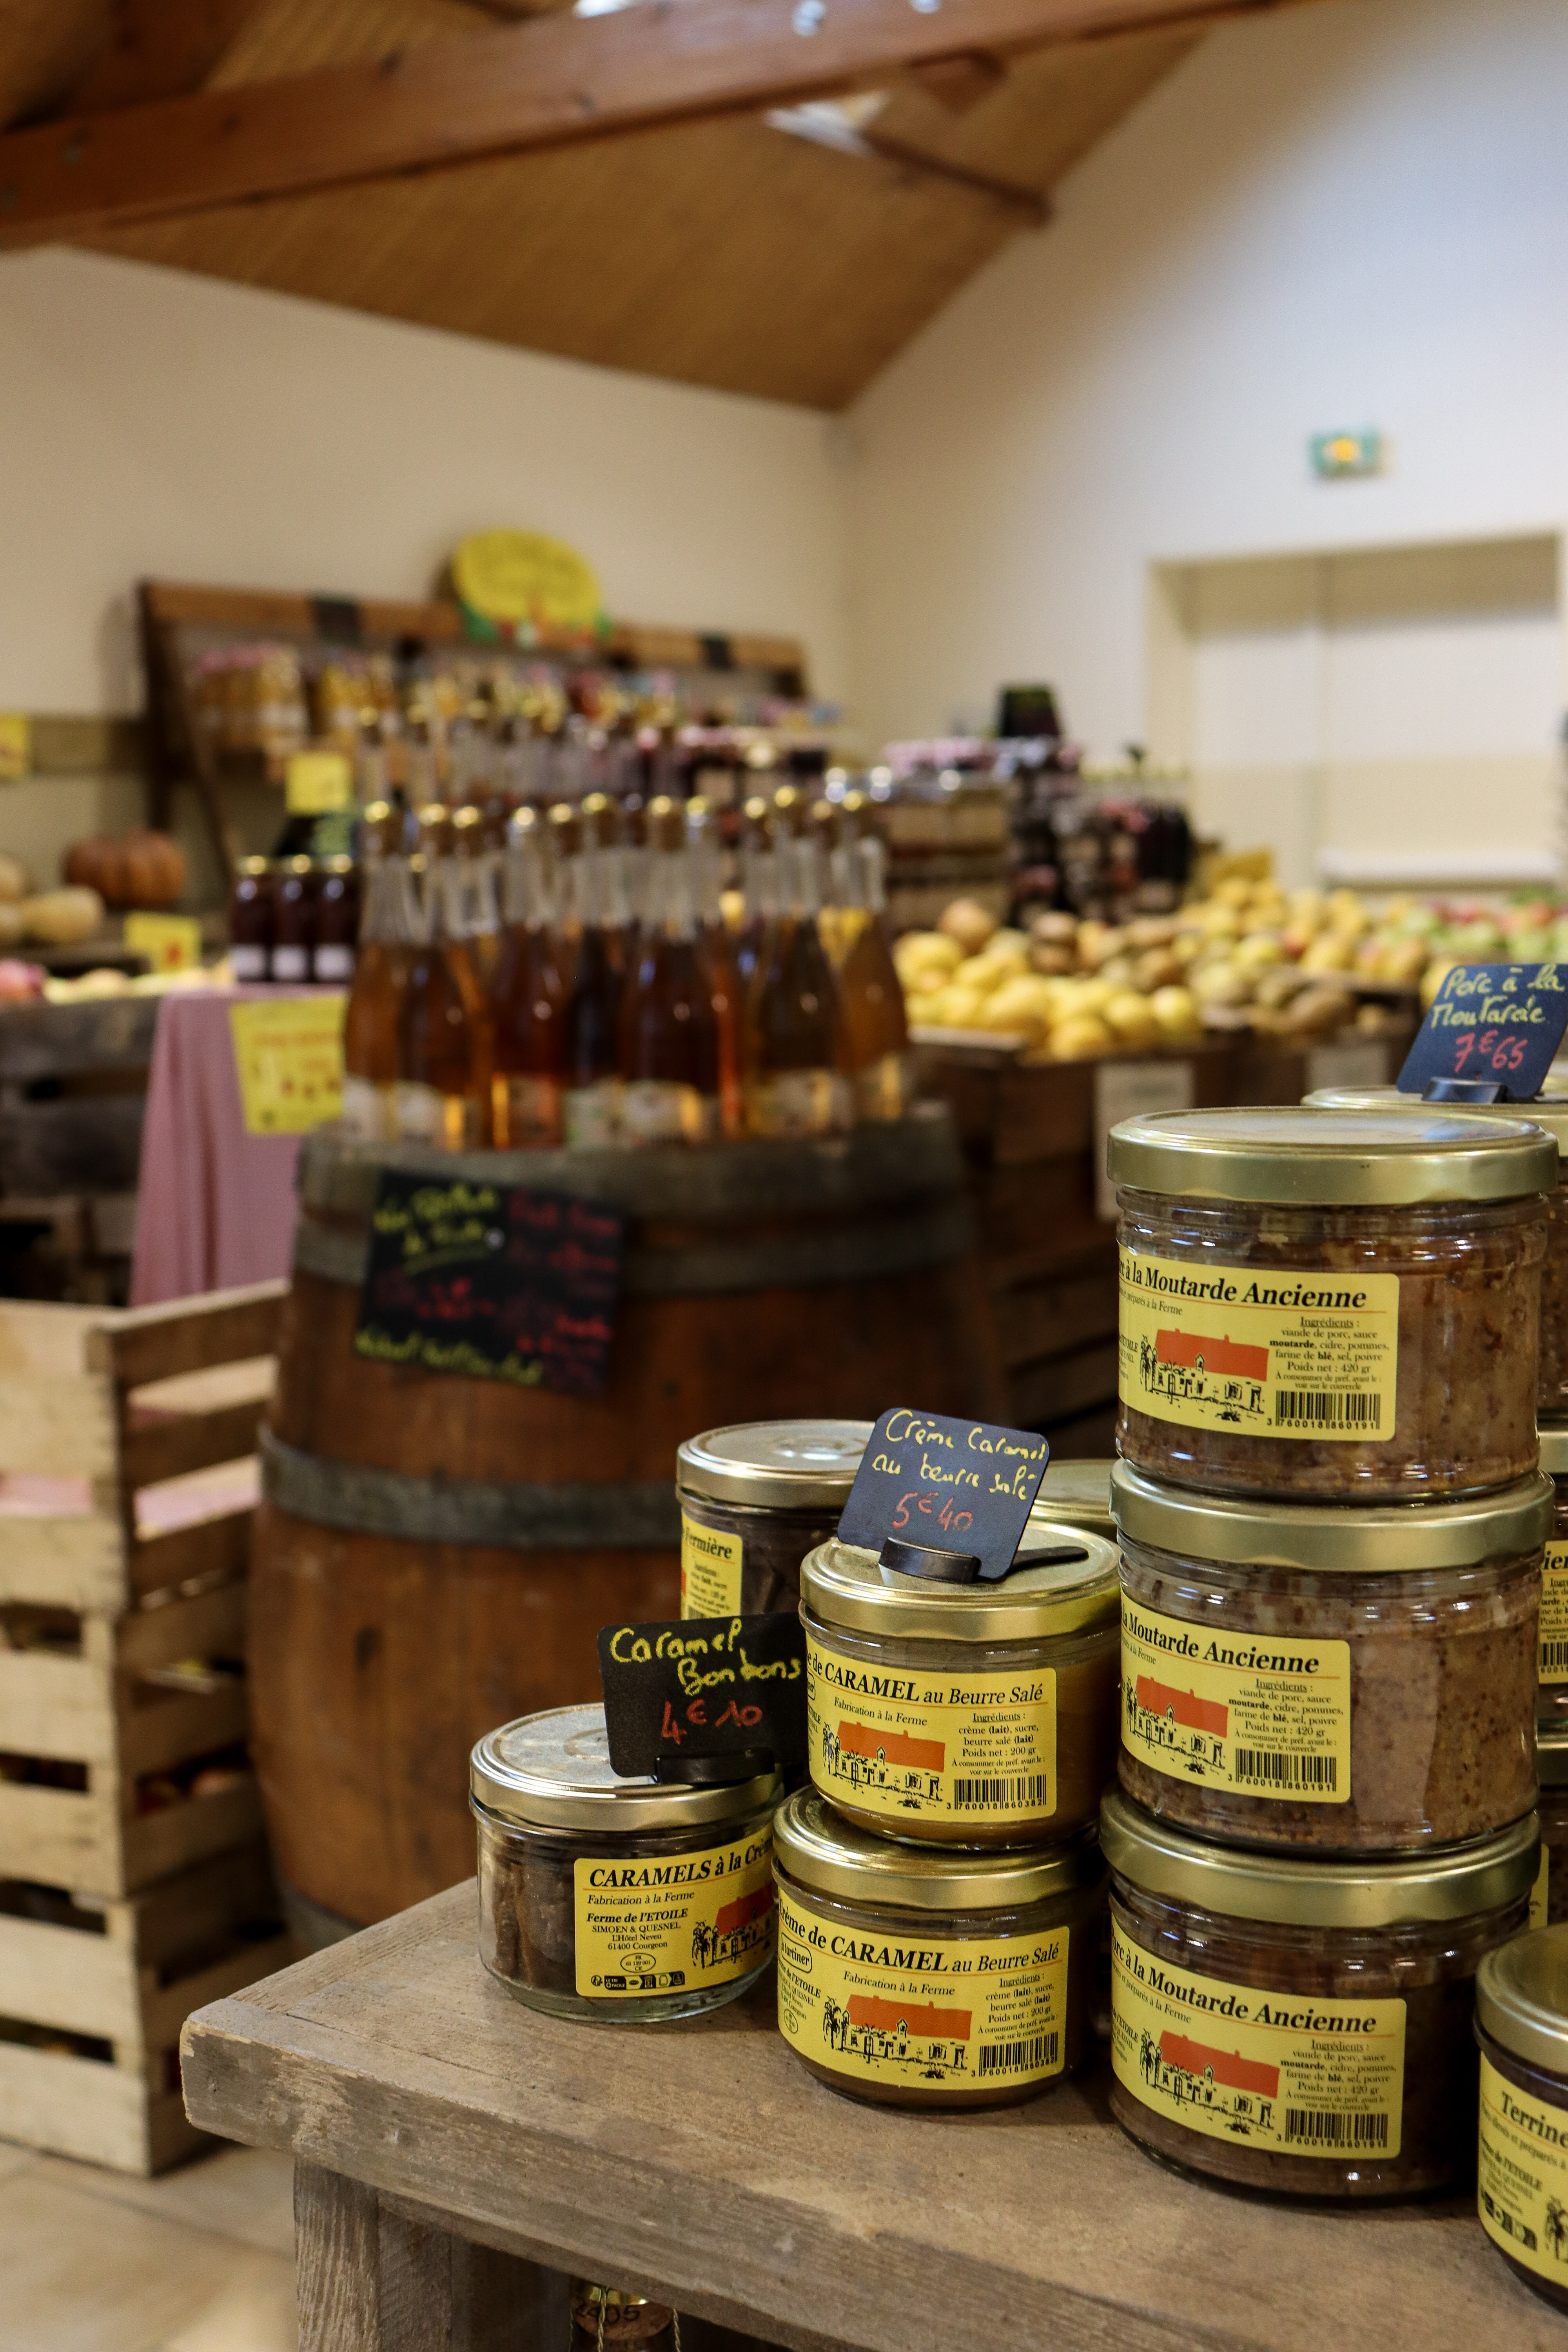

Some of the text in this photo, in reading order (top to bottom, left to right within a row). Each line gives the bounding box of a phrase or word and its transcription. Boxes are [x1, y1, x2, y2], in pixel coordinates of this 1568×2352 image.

[1444, 967, 1492, 999] Porc
[1527, 963, 1564, 992] la
[1125, 1259, 1366, 1308] à la Moutarde Ancienne
[1152, 1299, 1156, 1310] la
[1159, 1300, 1183, 1315] Ferme
[1300, 1316, 1354, 1328] Ingrédients
[1281, 1328, 1312, 1337] viande
[1313, 1328, 1325, 1338] de
[1327, 1330, 1351, 1339] porc,
[1319, 1340, 1345, 1350] cidre,
[1348, 1343, 1390, 1352] pommes,
[1275, 1349, 1301, 1359] farine
[1303, 1350, 1315, 1359] de
[1337, 1352, 1352, 1361] sel,
[1354, 1352, 1383, 1362] poivre
[1287, 1361, 1358, 1372] Poids net 420
[886, 1409, 1046, 1460] Crème Caramel
[872, 1454, 901, 1475] au
[920, 1452, 979, 1488] beurre
[610, 1617, 742, 1663] Caramel
[1128, 1612, 1199, 1657] Moutarde
[1202, 1641, 1319, 1673] Ancienne
[1138, 1646, 1156, 1665] Ferme
[813, 1652, 822, 1675] de
[825, 1662, 919, 1701] CARAMEL
[923, 1691, 943, 1704] au
[947, 1688, 1005, 1705] Beurre
[1009, 1683, 1043, 1704] Salé
[1256, 1678, 1308, 1693] Ingrédients
[1239, 1687, 1266, 1699] viande
[1268, 1691, 1279, 1700] de
[1282, 1693, 1305, 1702] porc,
[834, 1697, 927, 1726] Fabrication à la Ferme
[1234, 1707, 1257, 1719] farine
[1259, 1711, 1270, 1721] de
[1292, 1715, 1306, 1724] sel,
[1308, 1715, 1338, 1726] poivre
[1275, 1702, 1299, 1713] cidre,
[1302, 1706, 1344, 1716] pommes,
[972, 1712, 1020, 1723] Ingrédients
[958, 1726, 986, 1734] crème
[1014, 1724, 1039, 1732] sucre,
[1245, 1720, 1313, 1736] Poids net 420
[964, 1734, 1034, 1746] beurre salé (lait)
[962, 1748, 986, 1757] Poids
[1010, 1746, 1026, 1756] 200
[1027, 1747, 1036, 1756] gr
[1001, 1766, 1029, 1775] couvercle
[1005, 1759, 1019, 1767] préf.
[946, 1802, 951, 1810] 3
[1004, 1798, 1043, 1809] 860382
[589, 1859, 712, 1888] CARAMELS
[714, 1856, 724, 1875] à
[728, 1852, 741, 1867] la
[587, 1891, 694, 1905] Fabrication à la Ferme
[587, 1908, 688, 1923] Ferme de l'ETOILE
[592, 1925, 627, 1933] SIMOEN
[639, 1922, 681, 1933] QUESNEL
[779, 1897, 1060, 1973] Crème de CARAMEL au Beurre Salé
[632, 1941, 668, 1950] Courgeon
[784, 1942, 810, 1967] tartiner
[792, 1972, 821, 1999] l'ETOILE
[843, 1970, 956, 1996] Fabrication à la Ferme
[999, 1973, 1040, 1987] Ingrédients
[791, 1985, 815, 2007] QUESNEL
[985, 1992, 1011, 2001] crème
[1034, 1983, 1054, 1993] sucre,
[1125, 1947, 1131, 1970] à
[1133, 1954, 1145, 1981] la
[1148, 1965, 1248, 2019] Moutarde
[1252, 2003, 1377, 2034] Ancienne
[990, 2002, 1016, 2012] beurre
[1018, 1998, 1032, 2008] salé
[1126, 1982, 1191, 2024] préparés à la Ferme
[988, 2013, 1011, 2024] Poids
[1031, 2006, 1044, 2017] 200
[1045, 2005, 1052, 2014] gr
